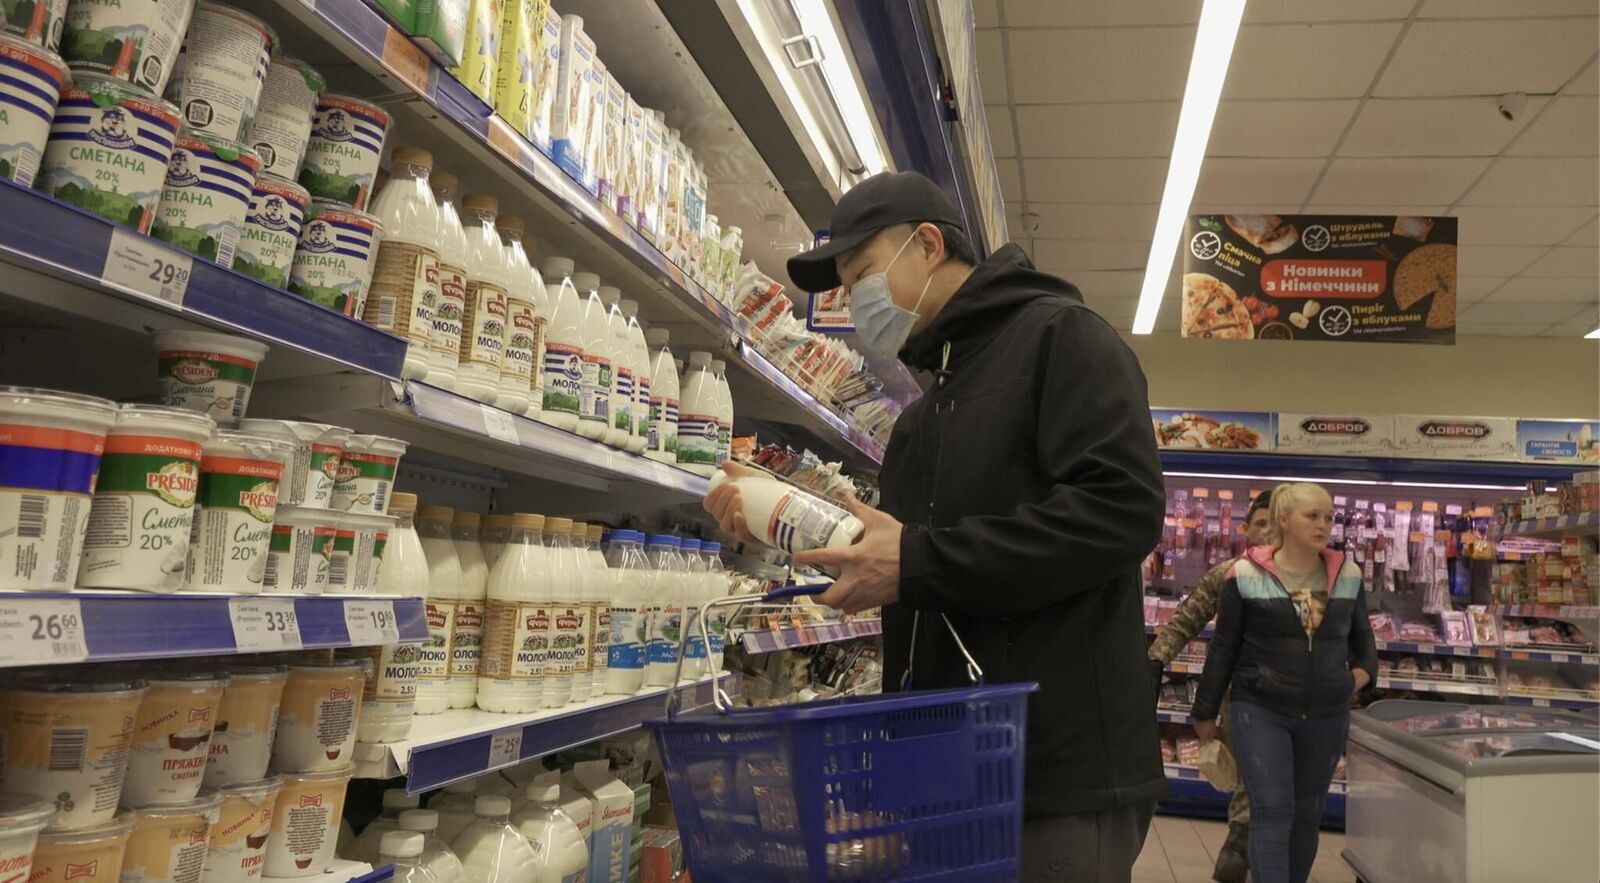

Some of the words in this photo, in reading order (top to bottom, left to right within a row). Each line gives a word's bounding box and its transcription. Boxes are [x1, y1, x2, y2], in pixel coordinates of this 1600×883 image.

[69, 147, 146, 175] СМЕТАНА
[323, 157, 341, 169] 20%
[95, 169, 120, 184] 20%
[165, 207, 188, 219] 20%
[260, 247, 280, 259] 20%
[1218, 252, 1242, 267] піца
[1223, 242, 1263, 265] Смачна
[148, 258, 176, 285] 29
[175, 267, 189, 281] 20
[306, 270, 326, 279] 20%
[1283, 264, 1363, 277] Новинки
[1266, 281, 1276, 291] з
[1280, 278, 1379, 293] Німеччини
[1351, 303, 1385, 317] Пиріг
[1361, 313, 1422, 328] яблуками
[170, 382, 216, 397] Сметана
[1307, 422, 1365, 432] ДОБРОВ
[1425, 425, 1485, 435] ДОБРОВ
[139, 533, 173, 551] 20%
[231, 545, 258, 561] 20%
[29, 613, 63, 640] 26
[62, 613, 78, 629] 60
[265, 611, 287, 632] 33
[285, 611, 295, 623] 30
[369, 611, 386, 629] 19
[140, 708, 180, 734] НОВИНКА
[221, 811, 256, 837] НОВИНКА
